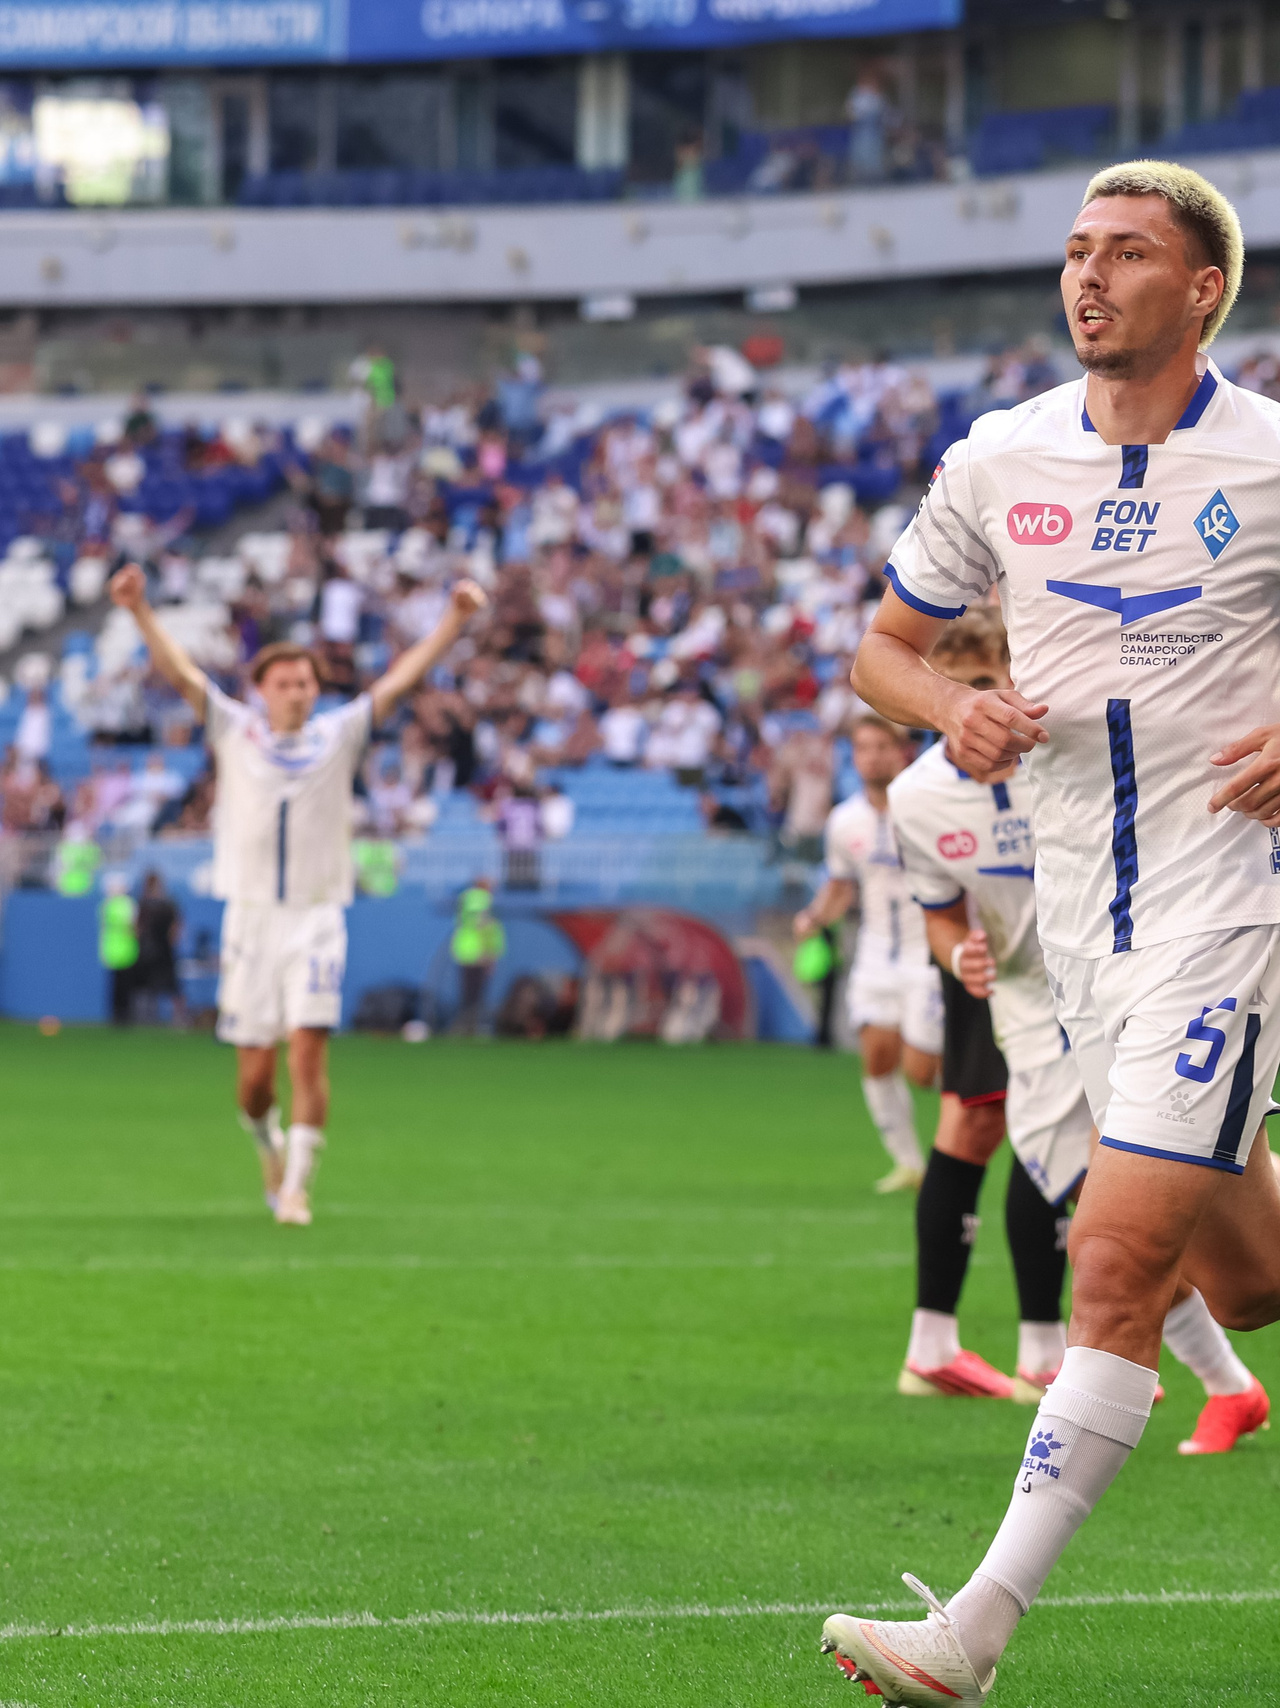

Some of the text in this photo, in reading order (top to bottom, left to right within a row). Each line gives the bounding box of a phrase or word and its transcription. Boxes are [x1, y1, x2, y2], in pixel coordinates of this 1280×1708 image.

[1012, 507, 1065, 537] wb
[1094, 500, 1161, 526] FON
[1091, 528, 1157, 552] BET
[1120, 633, 1223, 643] ПРАВИТЕЛЬСТВО
[1121, 644, 1196, 655] САМАРСКОЙ
[1120, 656, 1177, 666] ОБЛАСТИ
[992, 818, 1030, 836] FON
[997, 834, 1032, 856] BET
[1175, 997, 1237, 1083] 5
[1156, 1110, 1196, 1125] KELME
